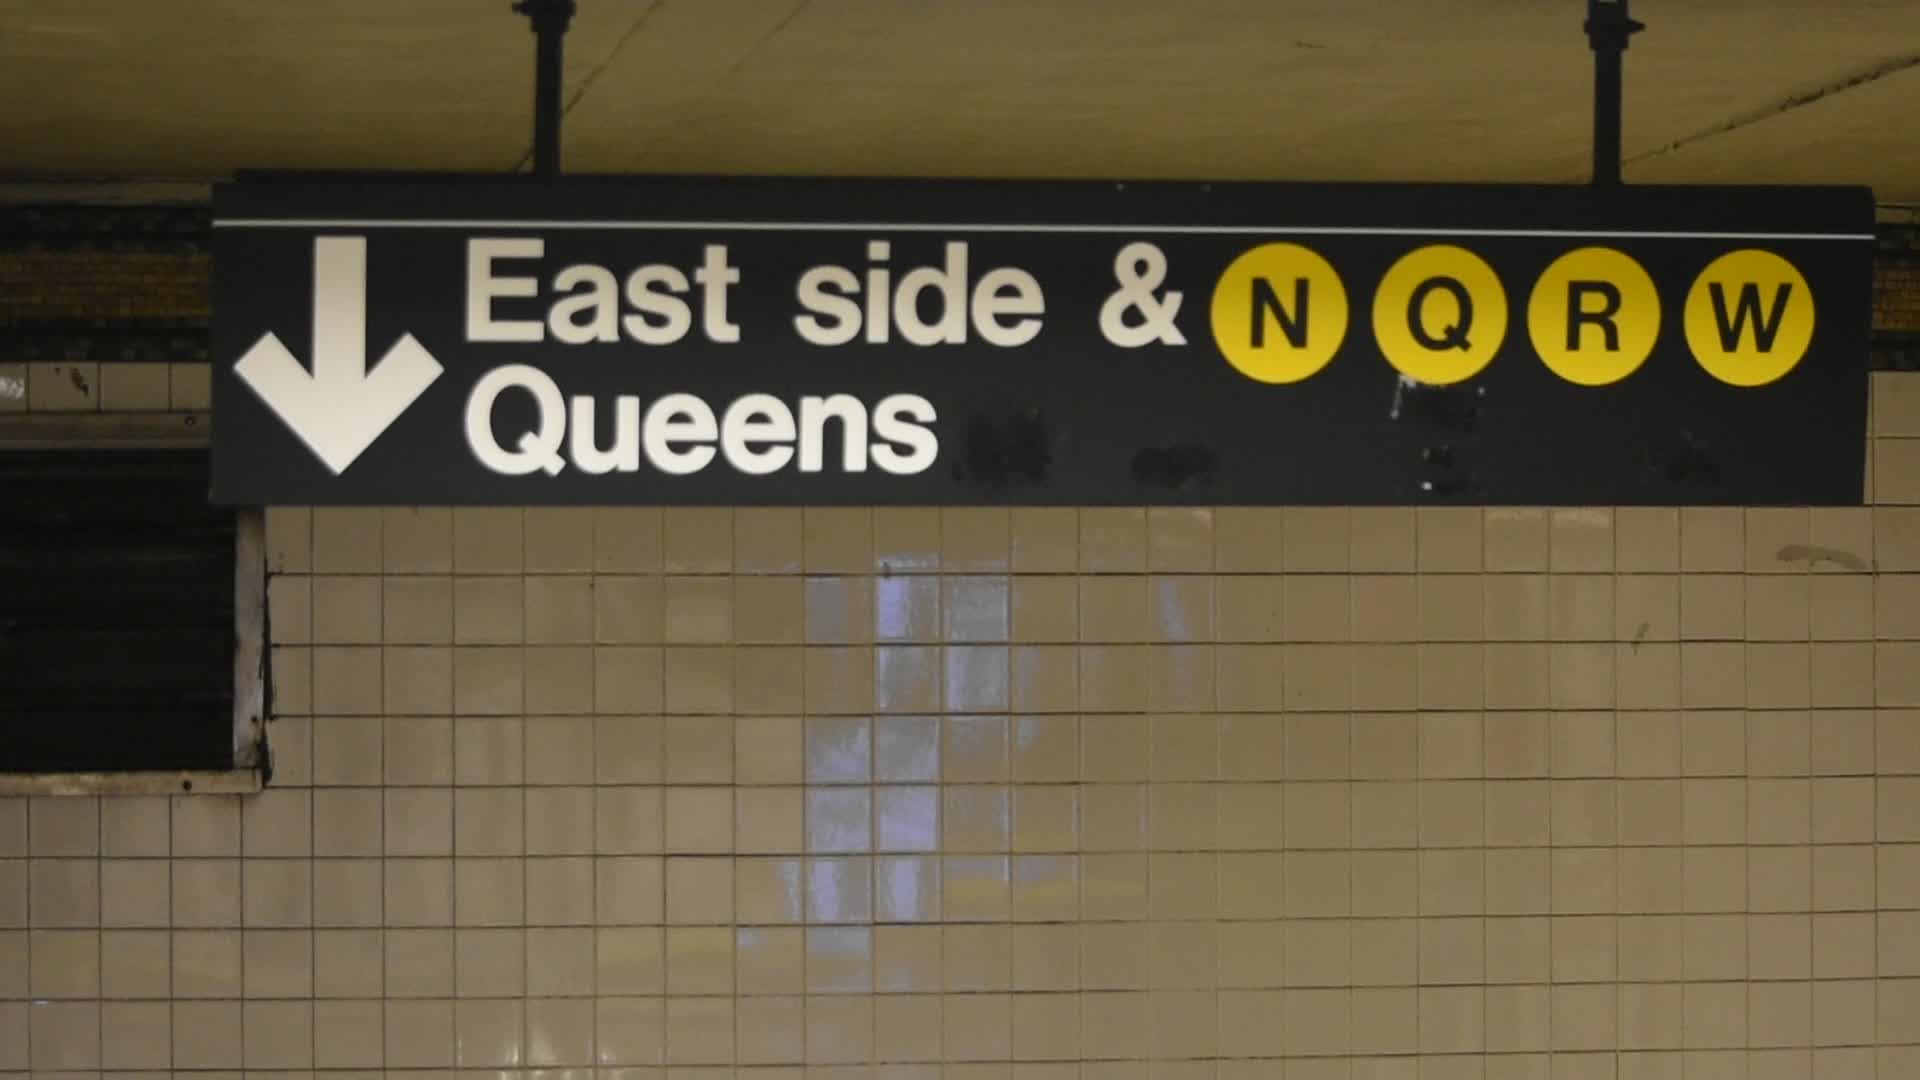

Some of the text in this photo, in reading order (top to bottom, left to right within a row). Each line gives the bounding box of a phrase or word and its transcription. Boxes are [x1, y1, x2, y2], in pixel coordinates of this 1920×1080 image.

[466, 238, 1793, 353] East side & N Q R W
[464, 364, 939, 477] Queens
